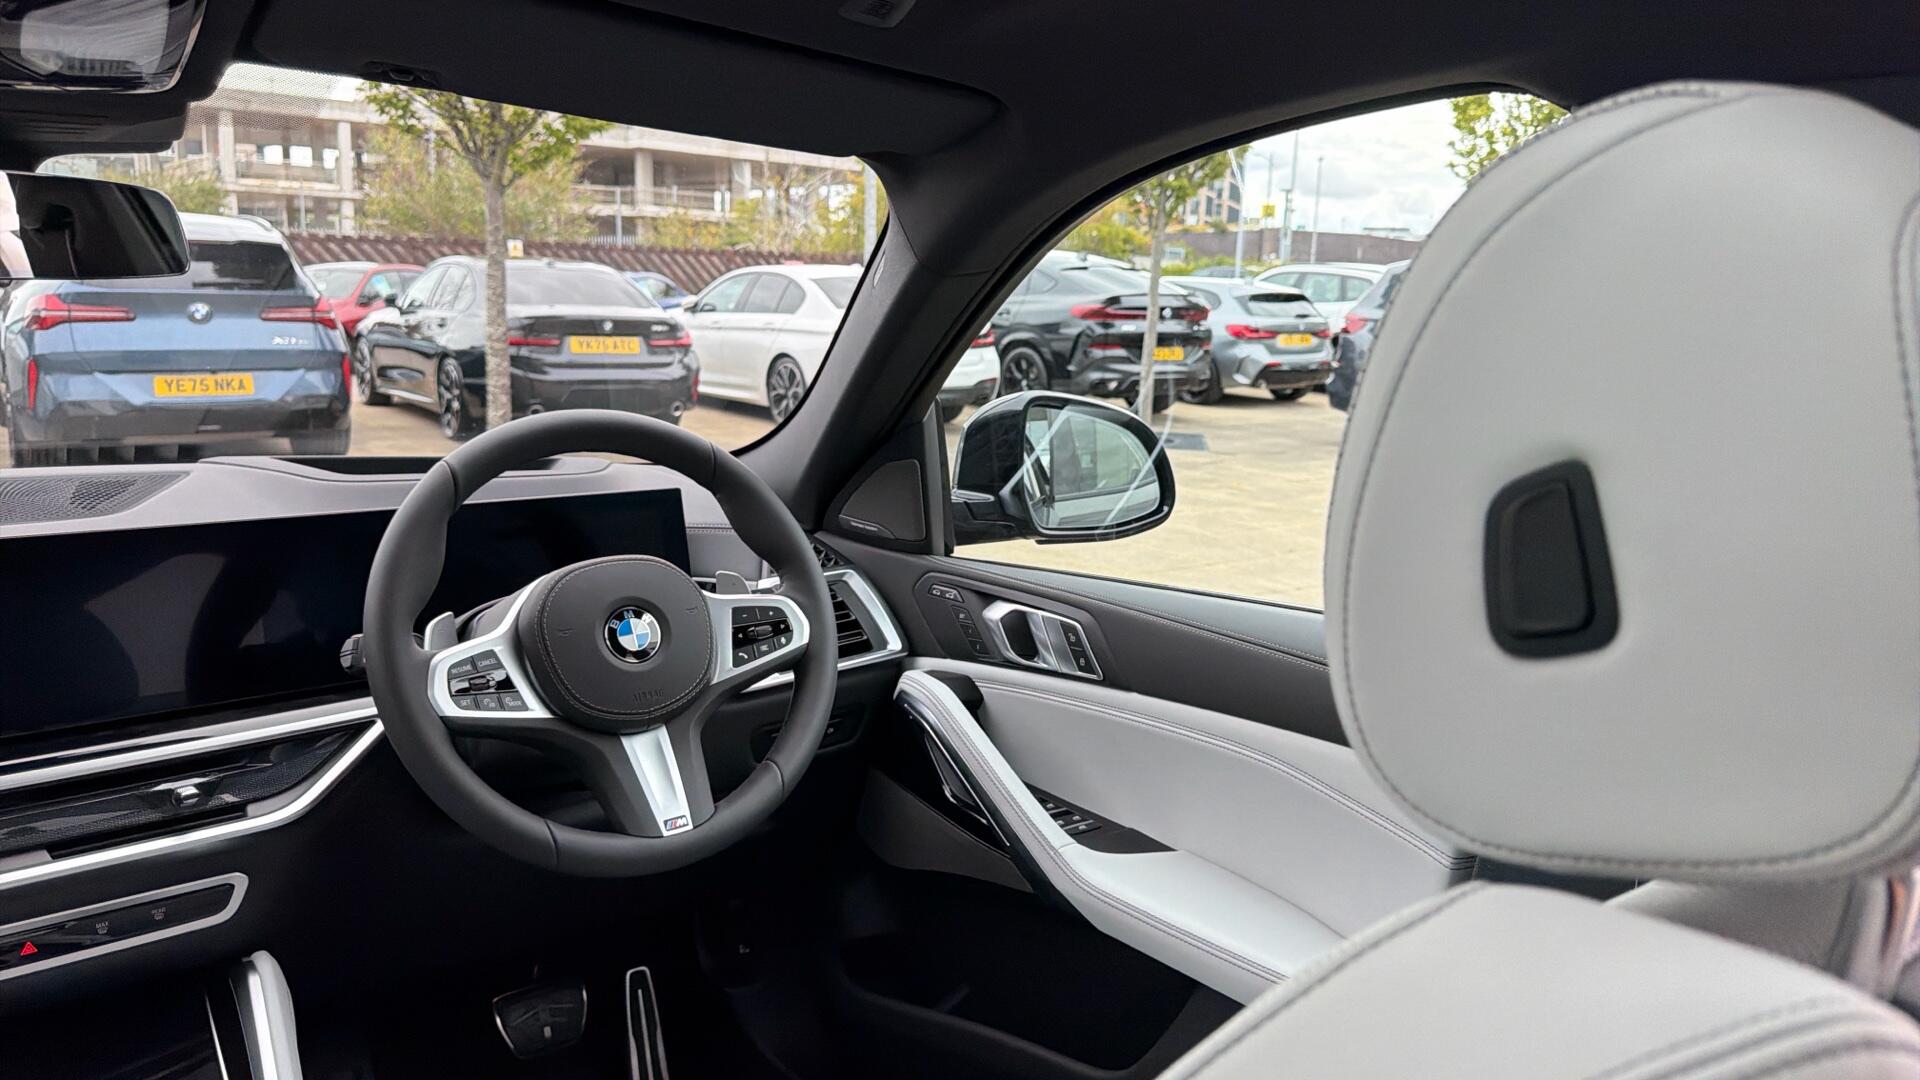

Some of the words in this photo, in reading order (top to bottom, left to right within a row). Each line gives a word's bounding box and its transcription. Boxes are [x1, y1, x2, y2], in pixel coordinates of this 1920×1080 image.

[164, 378, 210, 393] YE75
[215, 376, 247, 391] NKA
[609, 610, 654, 629] BMW
